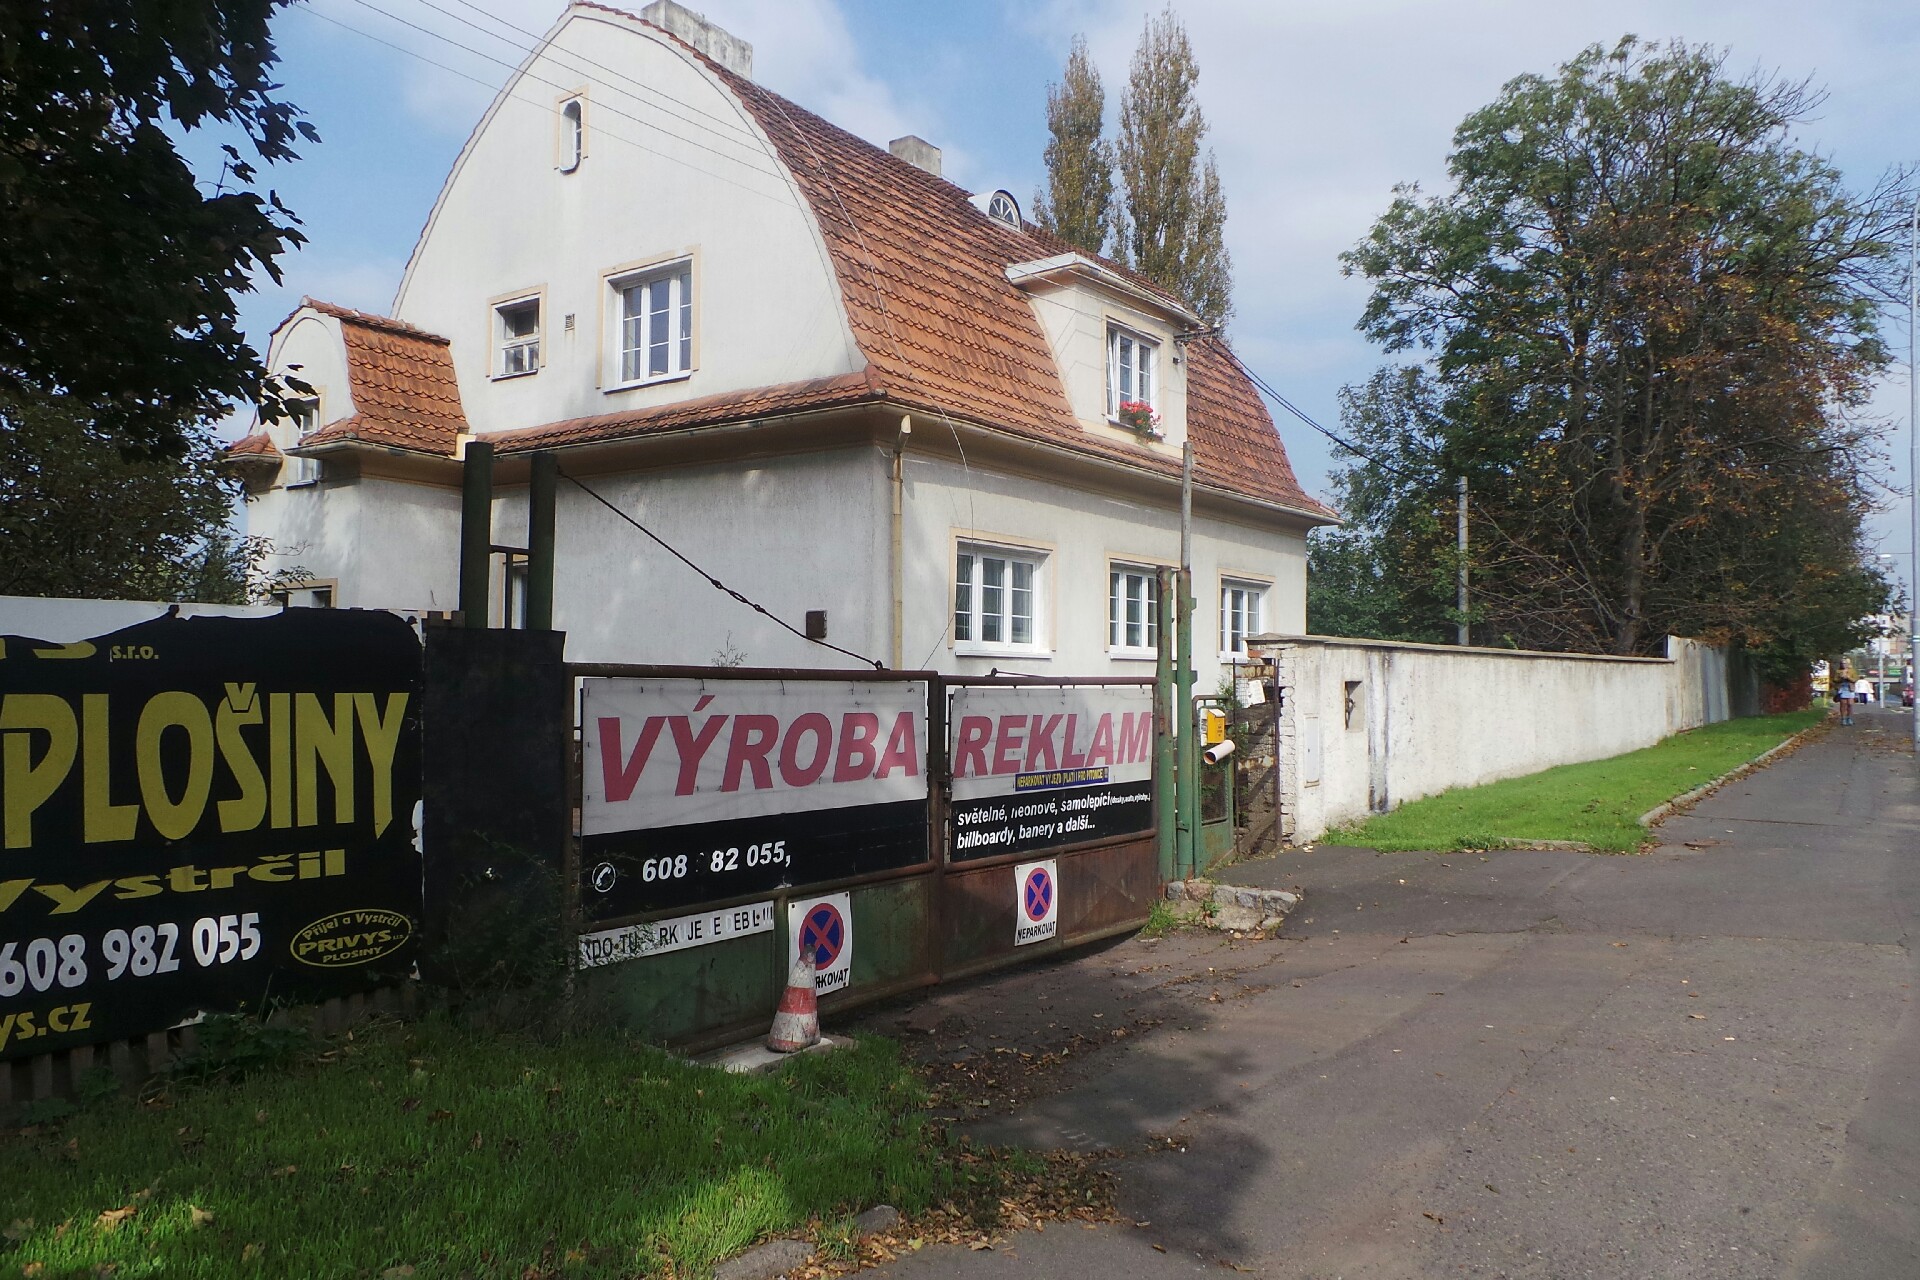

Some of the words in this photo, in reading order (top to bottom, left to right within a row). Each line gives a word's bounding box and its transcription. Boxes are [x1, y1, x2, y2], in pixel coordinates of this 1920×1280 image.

[113, 645, 159, 660] s.r.o.
[597, 694, 919, 803] VÝROBA
[952, 711, 1151, 779] REKLAM
[0, 682, 409, 849] PLOŠINY
[957, 805, 1008, 826] světelné,
[956, 828, 1016, 850] billboardy,
[1019, 822, 1056, 839] banery
[1057, 824, 1063, 834] a
[642, 854, 688, 882] 608
[697, 847, 739, 873] 82
[342, 916, 351, 925] a
[355, 912, 403, 928] Vystrčil
[1017, 921, 1056, 941] NEPARKOVAT
[0, 934, 88, 998] 608
[102, 922, 180, 981] 982
[192, 912, 261, 968] 055
[298, 929, 392, 956] PRIVYS
[815, 968, 849, 989] RKOVAT
